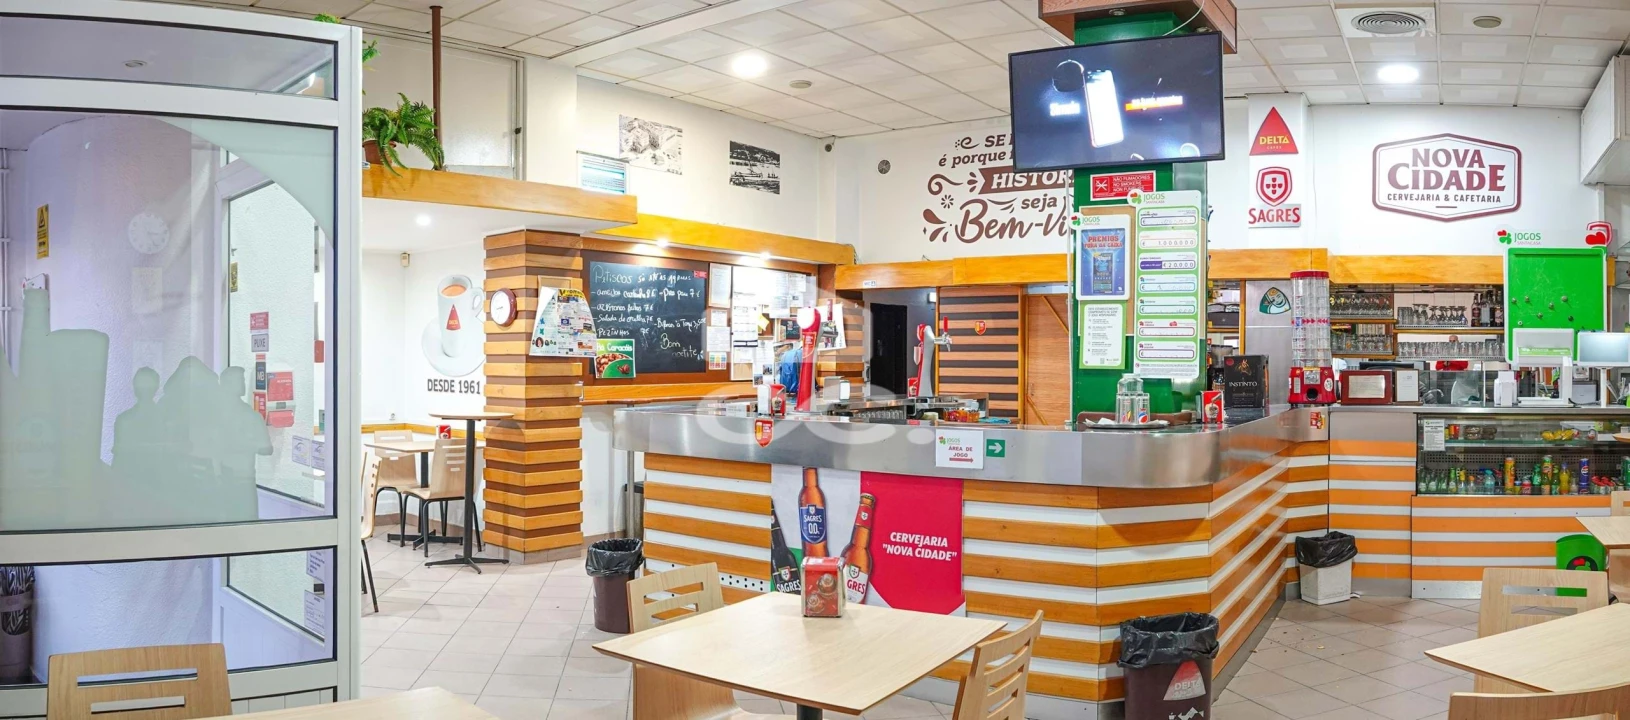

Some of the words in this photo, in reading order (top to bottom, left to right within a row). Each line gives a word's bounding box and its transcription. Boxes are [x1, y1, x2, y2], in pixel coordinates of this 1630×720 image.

[985, 134, 1006, 147] SE
[1260, 136, 1290, 145] DELTA
[939, 154, 947, 167] é
[951, 150, 1006, 168] porque
[1412, 148, 1485, 168] NOVA
[1388, 163, 1506, 192] CIDADE
[1021, 194, 1058, 212] seja
[1143, 193, 1165, 202] JOGOS
[1387, 193, 1440, 202] CERVEJARIA
[1444, 194, 1450, 202] &
[1454, 195, 1501, 204] CAFETARIA
[1082, 217, 1100, 225] JOGOS
[1249, 207, 1301, 225] SAGRES
[1513, 232, 1541, 242] JOGOS
[618, 313, 626, 322] de
[427, 378, 455, 393] DESDE
[458, 380, 481, 395] 1961
[804, 515, 822, 523] SAGRES
[889, 532, 948, 547] CERVEJARIA
[882, 544, 913, 558] "NOVA
[914, 548, 957, 562] CIDADE"
[777, 580, 801, 593] SAGRES
[847, 579, 865, 594] GRES
[1174, 680, 1201, 690] DELTA
